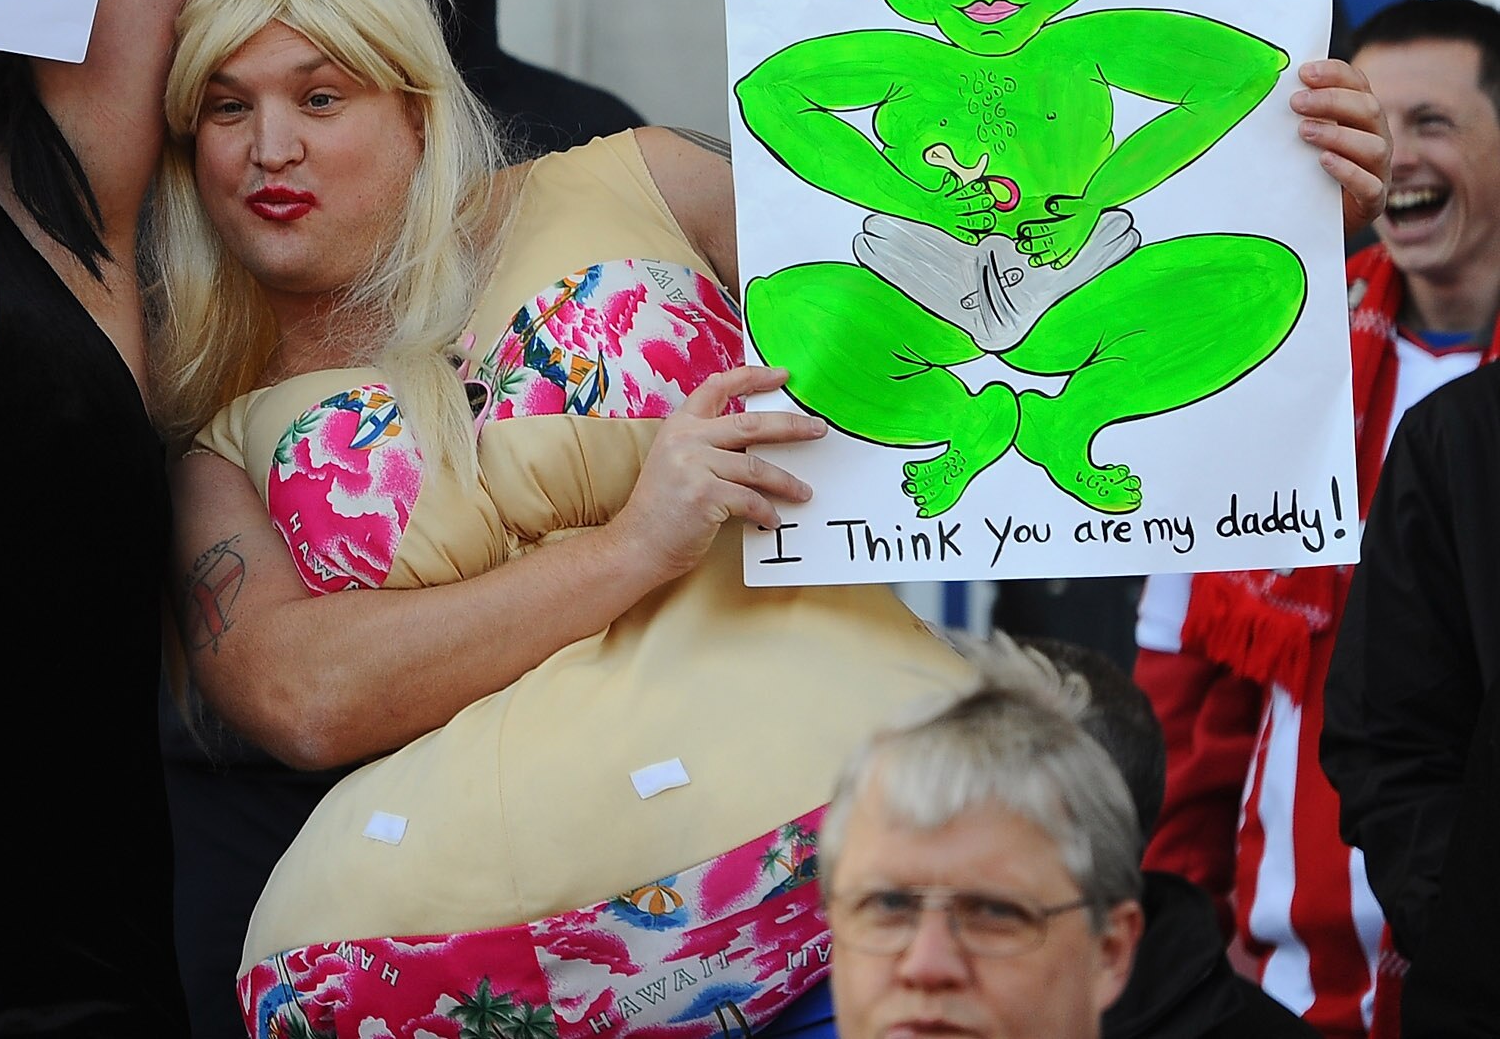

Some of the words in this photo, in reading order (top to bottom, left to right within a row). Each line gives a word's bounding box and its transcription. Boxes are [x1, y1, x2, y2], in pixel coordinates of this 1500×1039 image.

[757, 522, 803, 564] I
[1074, 519, 1133, 544] are
[1143, 515, 1195, 554] my
[1215, 475, 1346, 553] daddy!
[587, 948, 731, 1035] HAWAII
